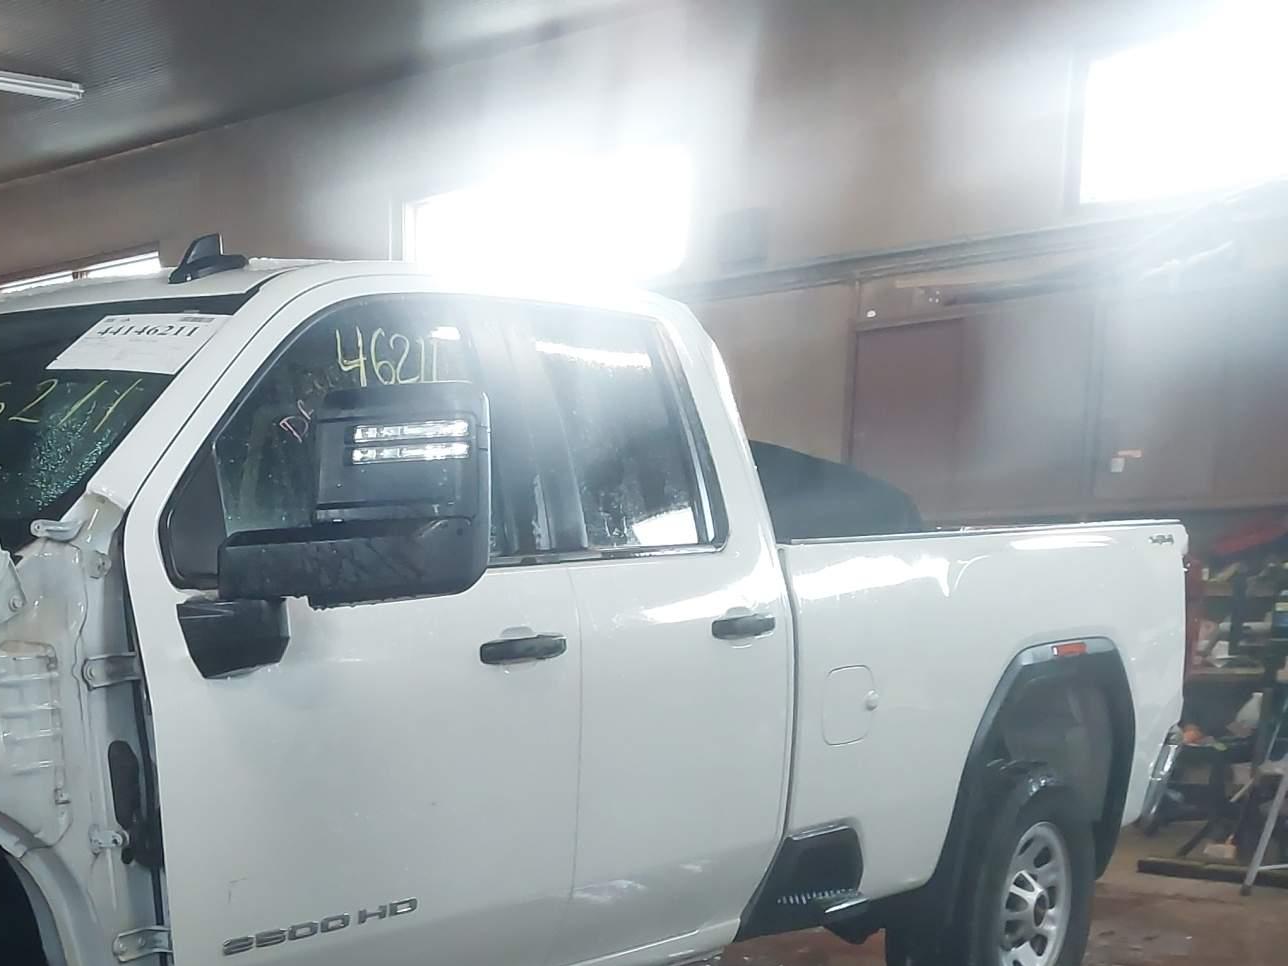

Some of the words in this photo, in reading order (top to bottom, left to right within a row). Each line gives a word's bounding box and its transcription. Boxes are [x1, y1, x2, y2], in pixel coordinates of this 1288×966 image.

[97, 325, 200, 337] 44146211
[335, 326, 442, 387] 46211
[358, 897, 418, 925] HD
